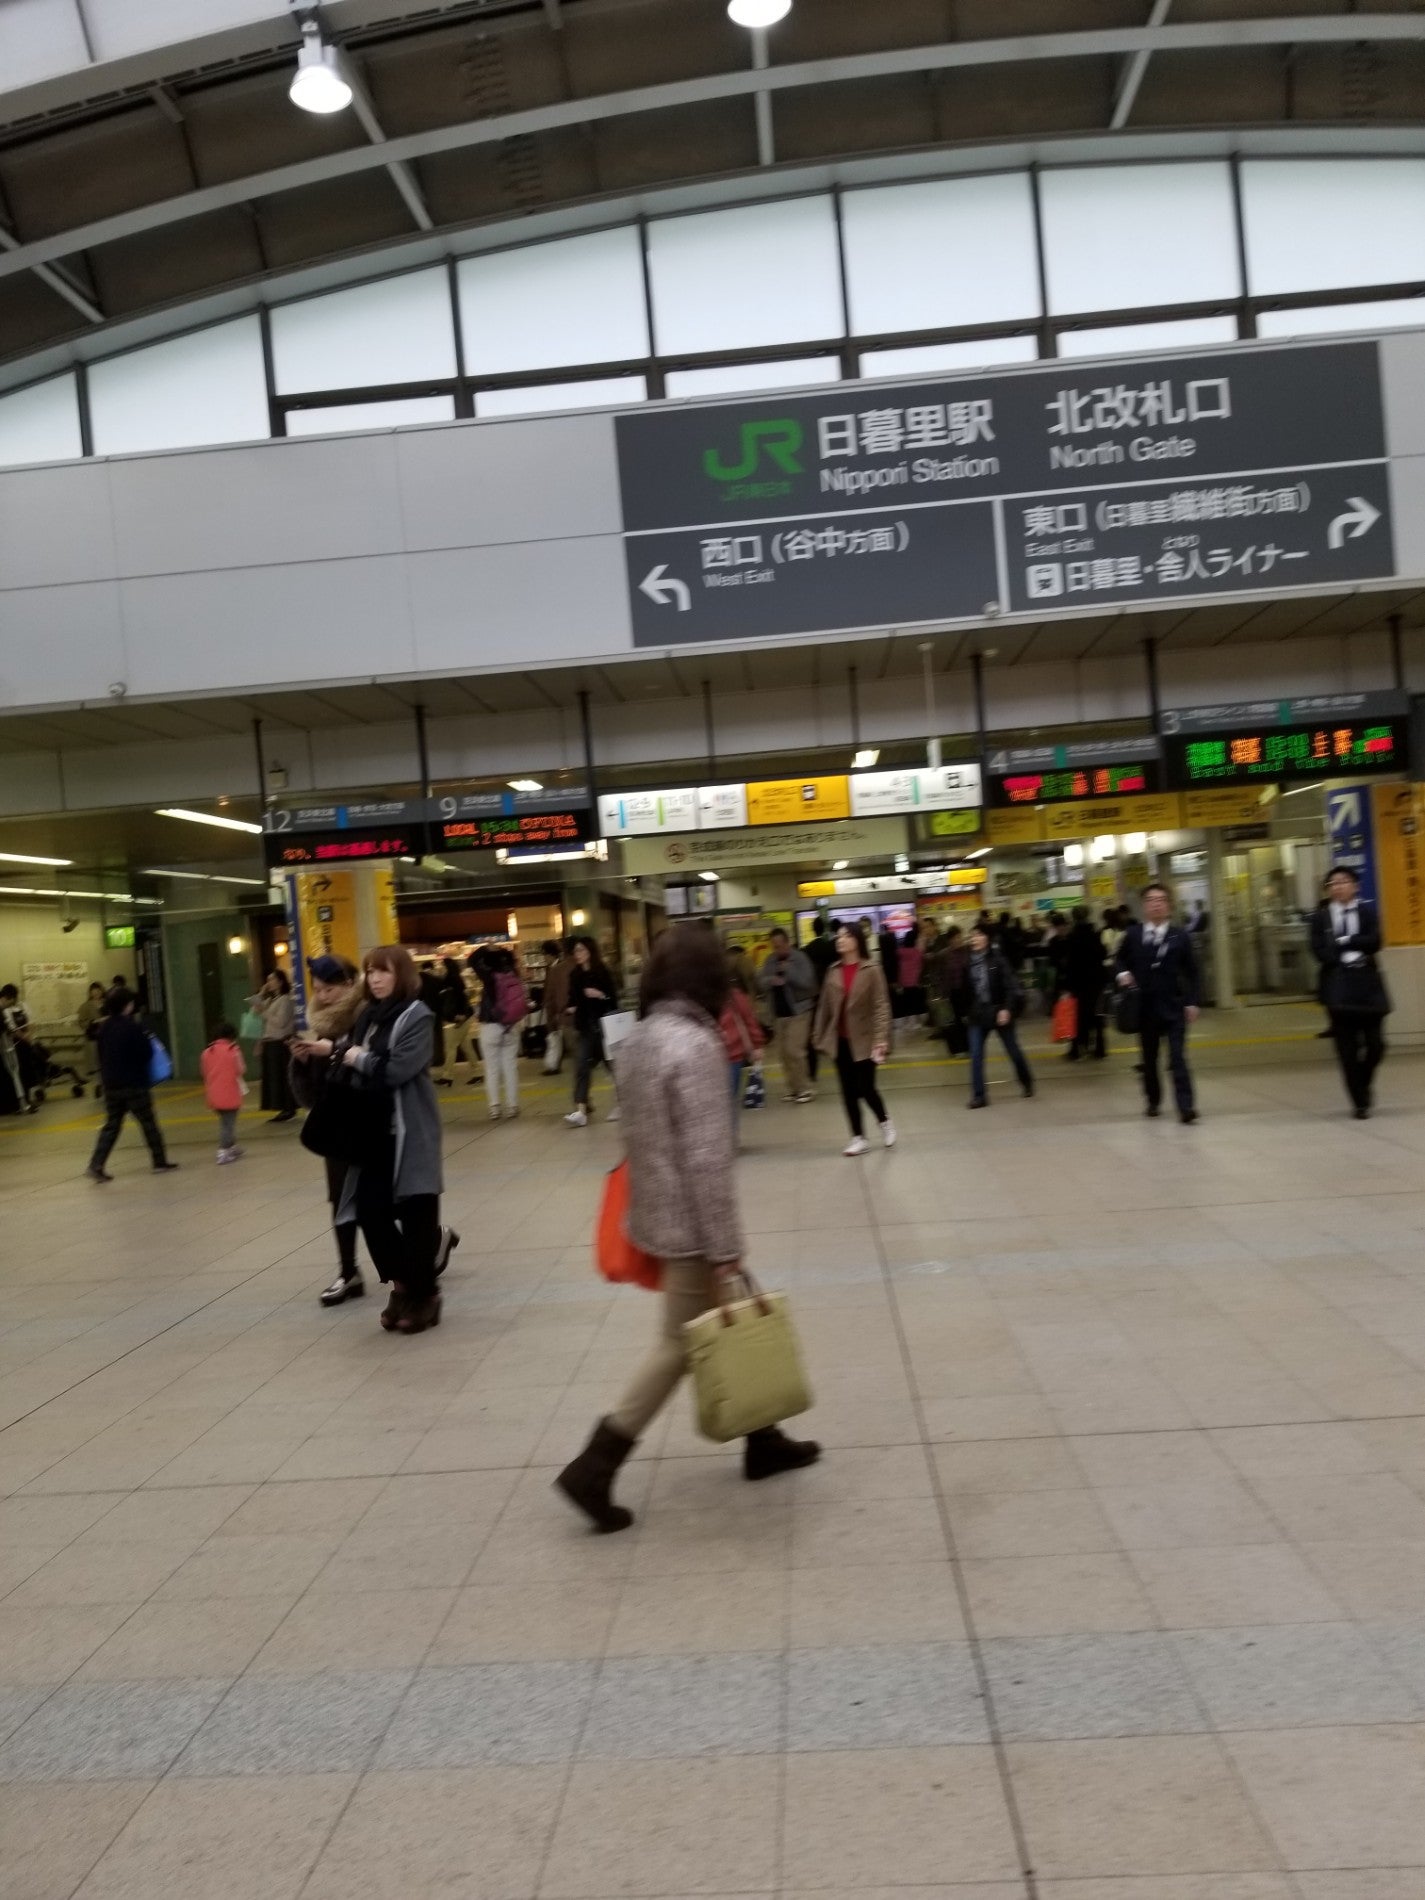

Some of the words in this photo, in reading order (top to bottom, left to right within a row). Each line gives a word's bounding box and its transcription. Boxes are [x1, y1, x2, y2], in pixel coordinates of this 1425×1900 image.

[1045, 377, 1232, 435] 北改札口
[817, 398, 996, 460] 日暮里駅
[703, 417, 806, 482] JR
[1050, 439, 1124, 470] North
[1129, 435, 1197, 463] Gate
[820, 460, 907, 496] Nippori
[912, 454, 999, 484] Station
[1022, 502, 1088, 537] 東口
[699, 534, 763, 570] 西口
[771, 520, 909, 564] (谷中方面)
[988, 750, 1008, 774] 4
[262, 808, 294, 834] 12
[439, 796, 458, 820] 9
